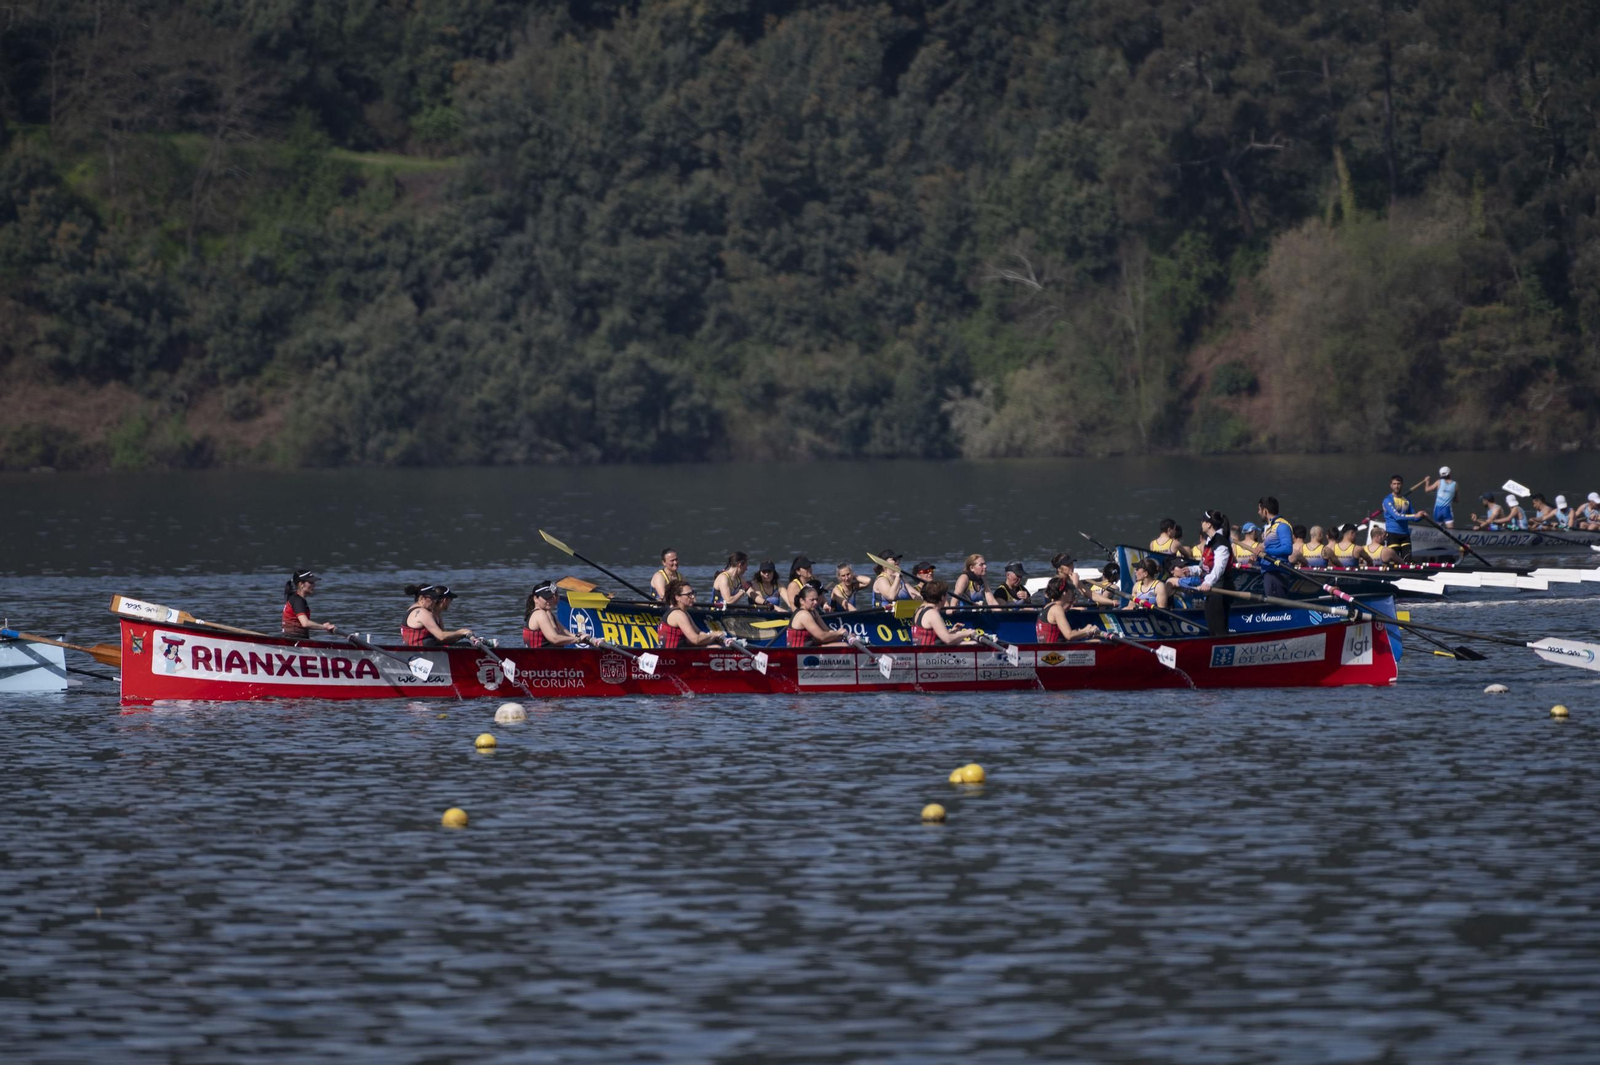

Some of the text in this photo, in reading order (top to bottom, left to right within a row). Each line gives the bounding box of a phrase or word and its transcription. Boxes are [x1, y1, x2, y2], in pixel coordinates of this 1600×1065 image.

[1453, 534, 1531, 546] MONDARIZ
[1241, 643, 1288, 655] XUNTA
[191, 645, 381, 679] RIANXEIRA
[926, 658, 967, 666] BRINCOS
[1238, 650, 1317, 664] DE GALICIA
